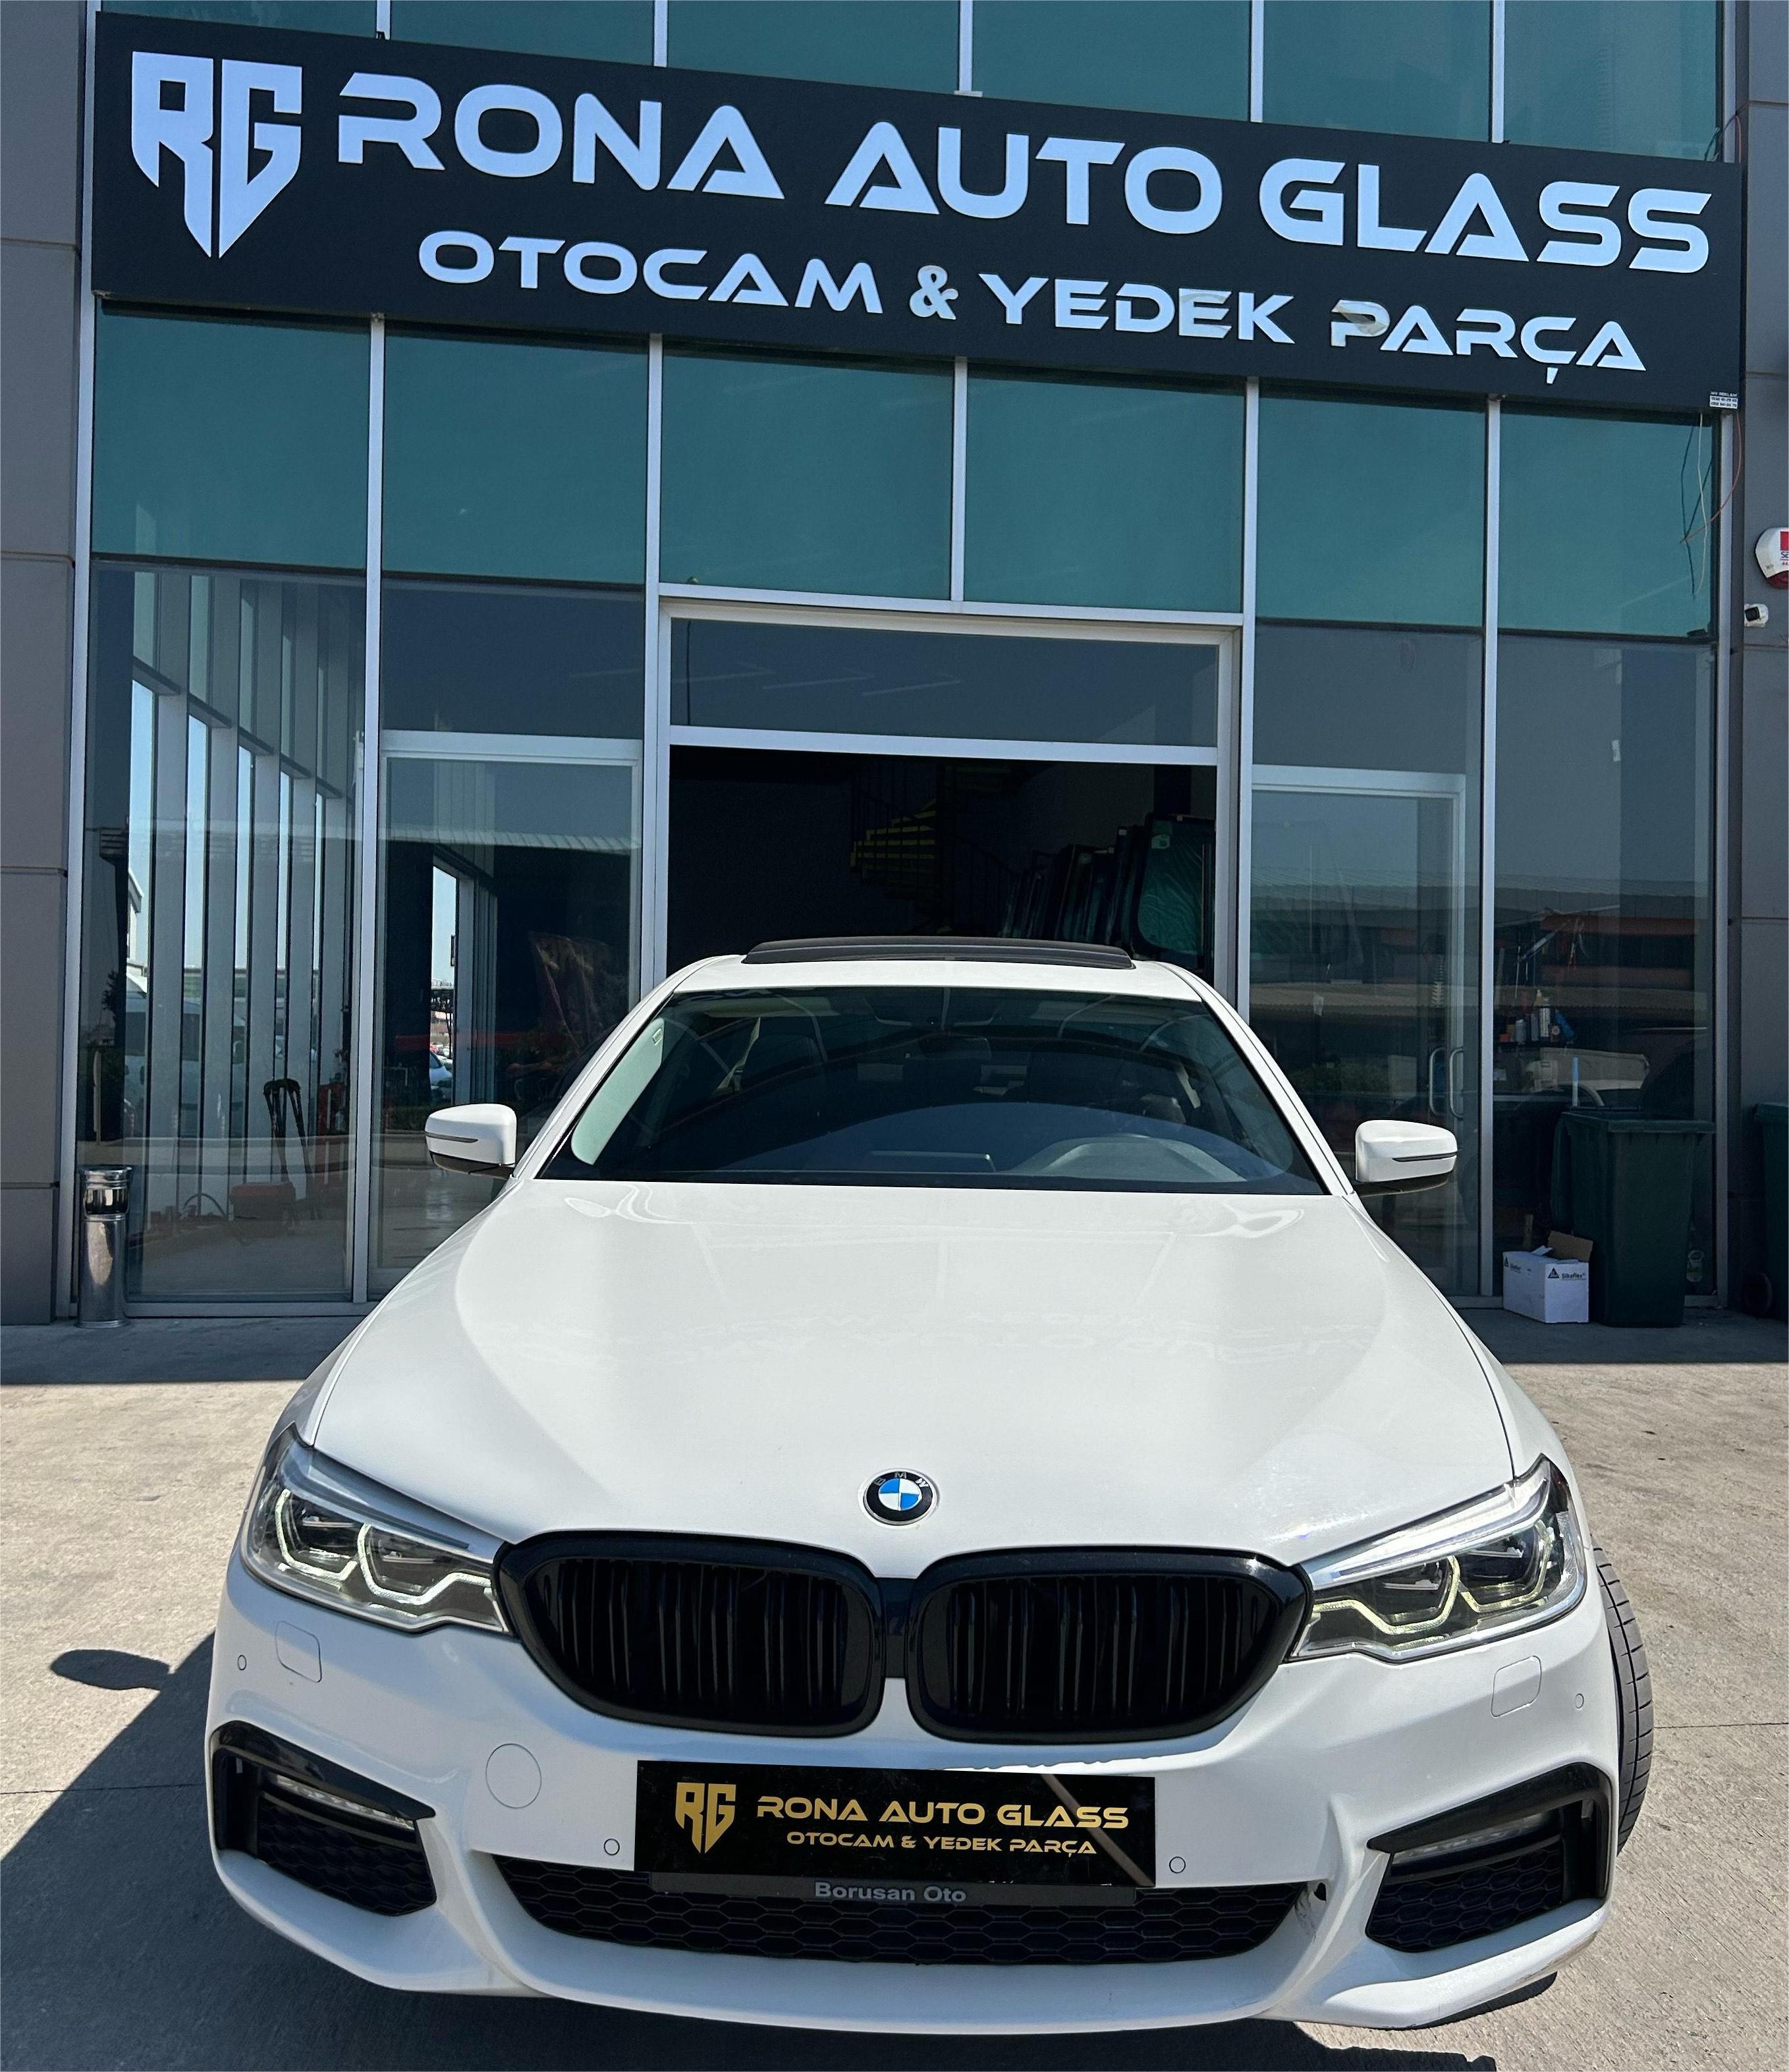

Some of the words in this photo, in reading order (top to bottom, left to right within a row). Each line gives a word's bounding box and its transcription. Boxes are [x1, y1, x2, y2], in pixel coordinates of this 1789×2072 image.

[131, 51, 302, 259] RG
[338, 72, 785, 200] RONA
[824, 121, 1223, 235] AUTO
[1259, 157, 1712, 273] GLASS
[418, 231, 883, 314] OTOCAM
[909, 265, 959, 320] &
[978, 273, 1296, 344] YEDEK
[1331, 299, 1647, 385] PARÇA
[873, 1471, 929, 1488] BMW
[675, 1782, 736, 1854] RG
[757, 1796, 867, 1822] RONA
[879, 1801, 985, 1825] AUTO
[997, 1804, 1129, 1829] GLASS
[786, 1832, 894, 1848] OTOCAM
[901, 1836, 916, 1849] &
[923, 1836, 1002, 1852] YEDEK
[1009, 1839, 1097, 1857] PARÇA
[814, 1882, 916, 1901] Borusan
[923, 1886, 967, 1903] Oto
